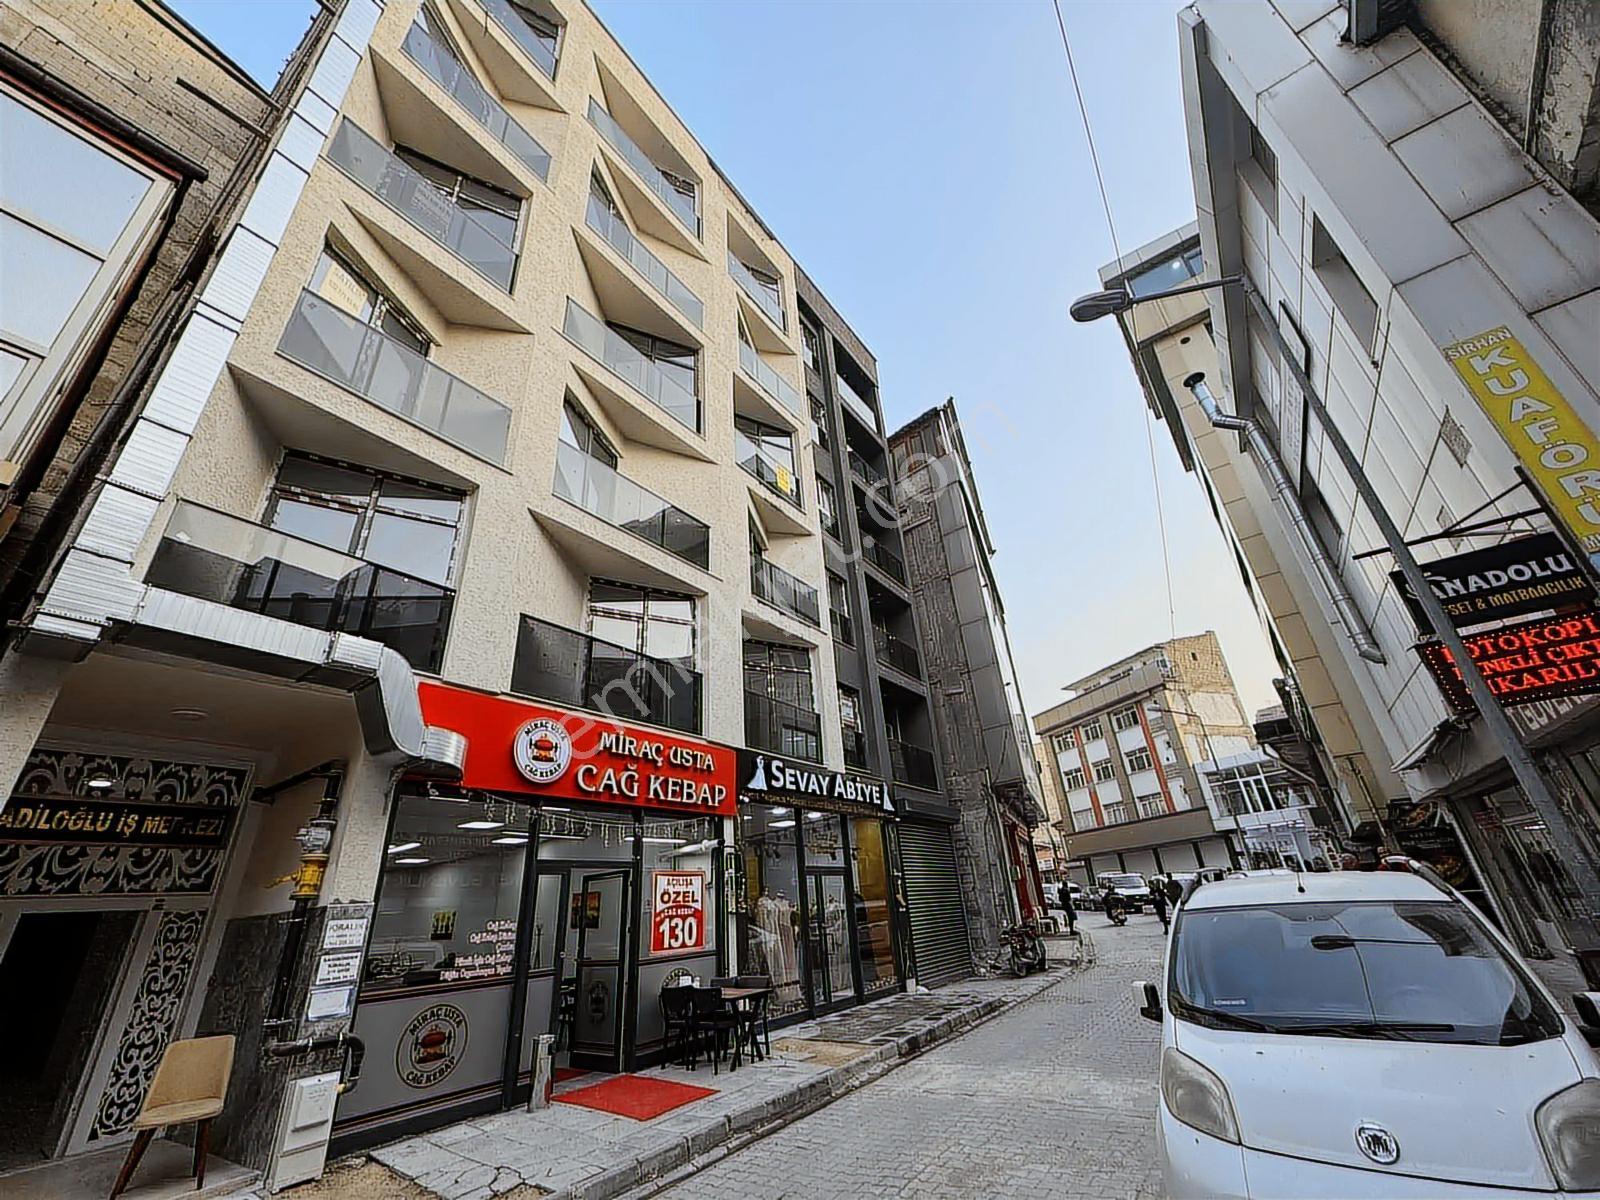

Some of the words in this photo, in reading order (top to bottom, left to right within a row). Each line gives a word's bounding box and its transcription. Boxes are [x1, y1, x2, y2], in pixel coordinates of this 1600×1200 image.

[1476, 597, 1488, 610] &
[599, 730, 665, 767] MİRAÇ
[669, 746, 715, 771] USTA
[577, 763, 640, 797] CAĞ
[648, 774, 727, 807] KEBAP
[770, 760, 829, 796] SEVAY
[833, 773, 881, 804] ABİYE
[115, 808, 140, 838] İŞ
[660, 888, 699, 904] ÖZEL
[659, 916, 697, 949] 130
